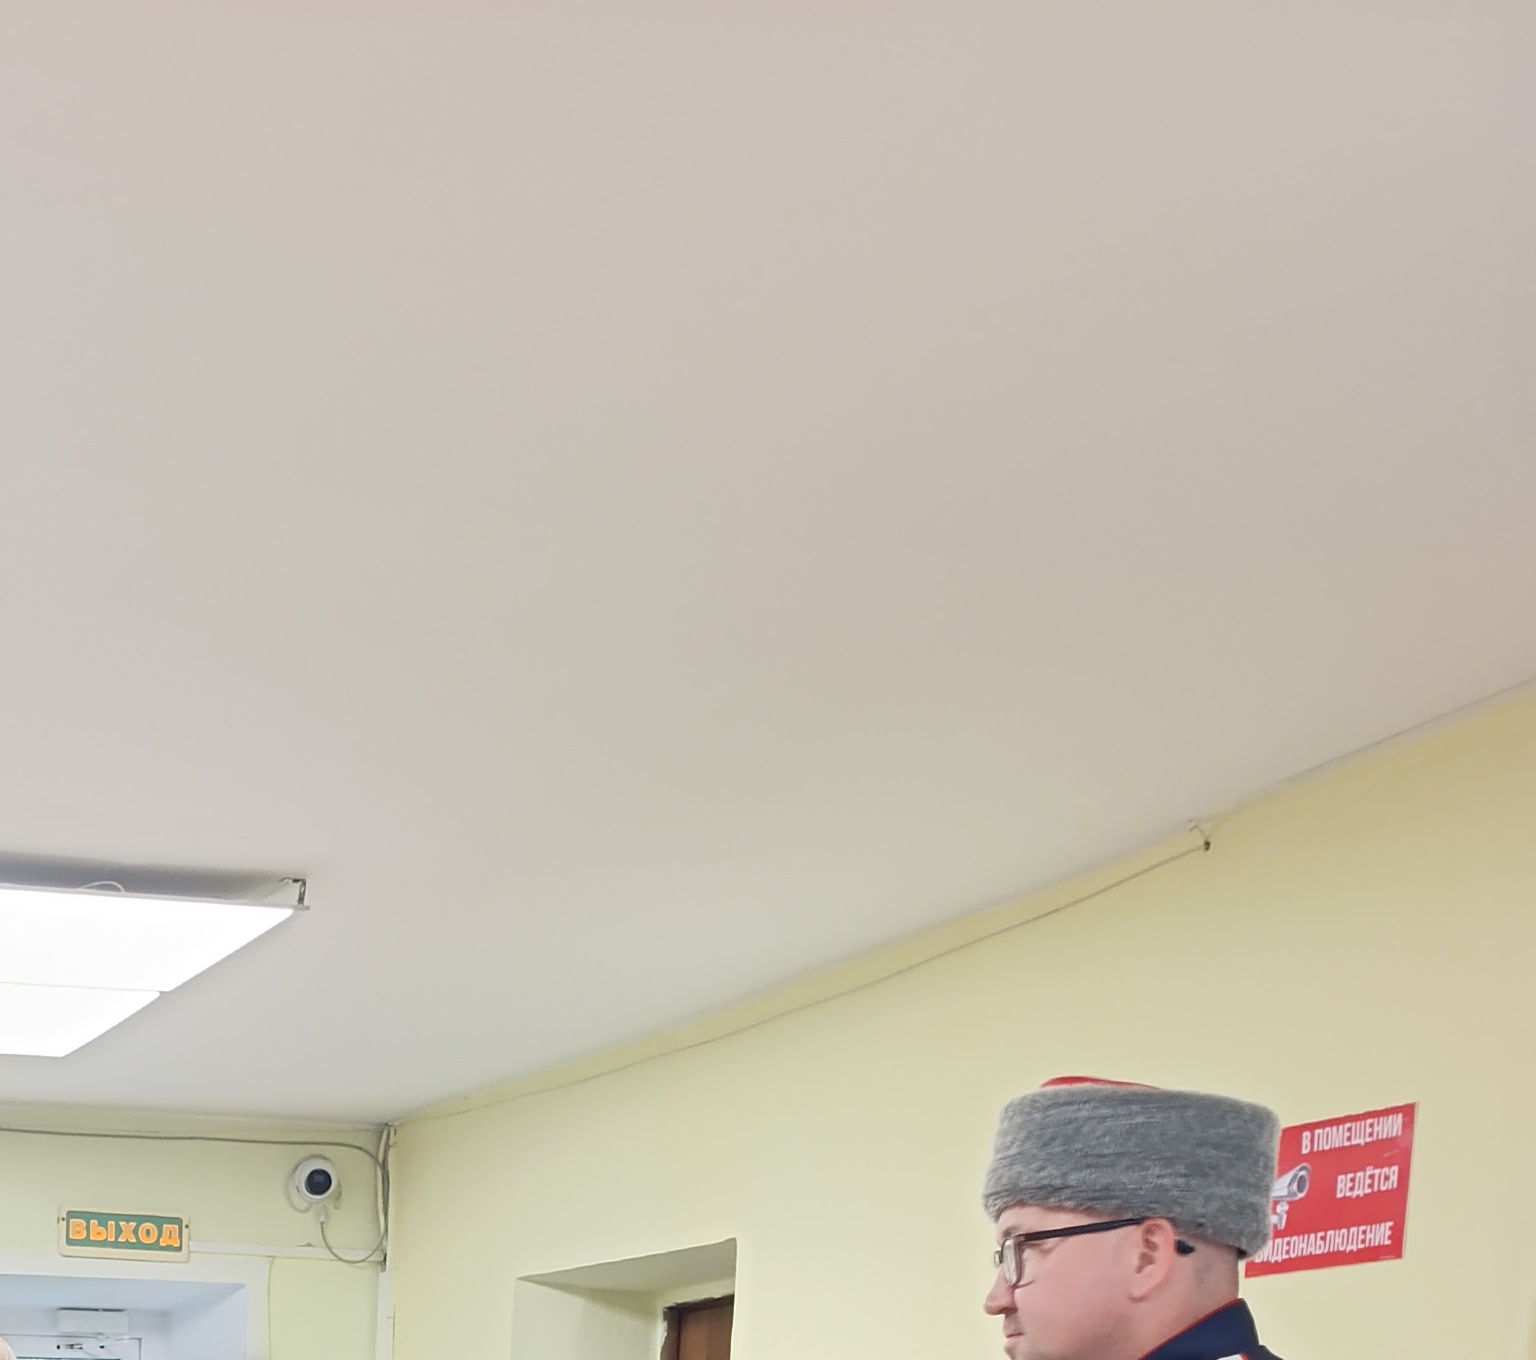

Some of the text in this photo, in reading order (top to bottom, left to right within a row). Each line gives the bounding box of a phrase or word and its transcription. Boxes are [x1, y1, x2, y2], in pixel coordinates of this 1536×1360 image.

[1301, 1113, 1403, 1154] В ПОМЕЩЕНИИ
[1336, 1165, 1399, 1198] ВЕДЁТСЯ
[69, 1218, 181, 1247] ВЫХОД
